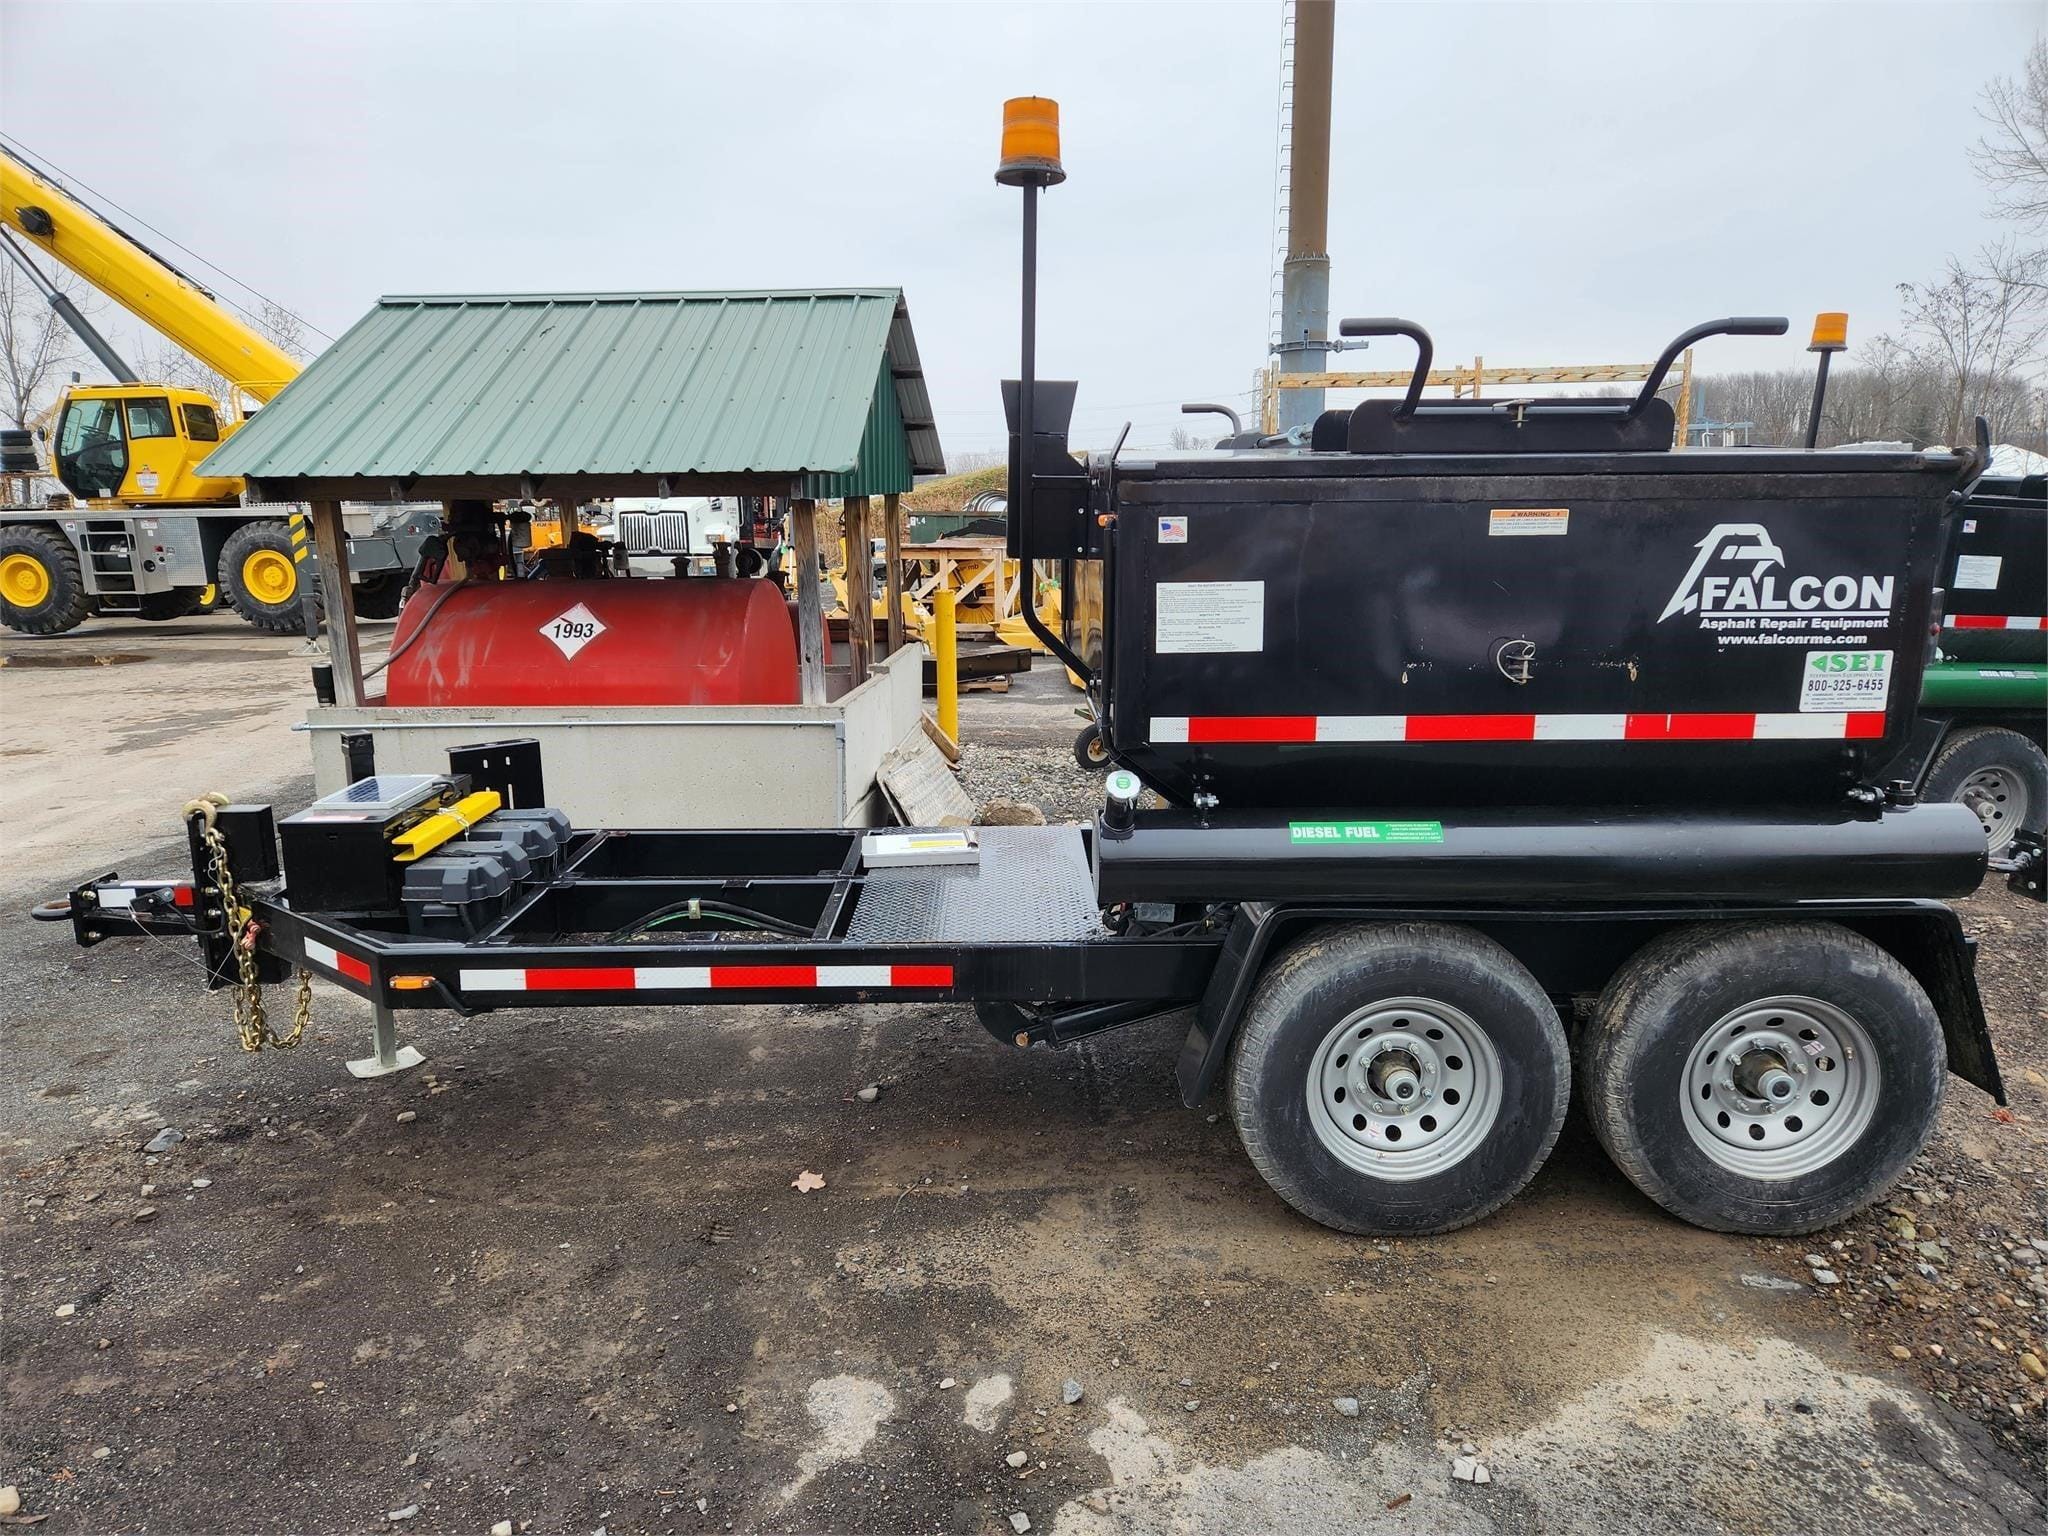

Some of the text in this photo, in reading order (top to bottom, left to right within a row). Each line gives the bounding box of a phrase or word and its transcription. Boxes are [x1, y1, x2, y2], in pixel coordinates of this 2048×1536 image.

[1700, 575, 1895, 610] FALCON
[553, 622, 594, 639] 1993
[1699, 617, 1889, 631] Asphalt Repair Equipment
[1717, 633, 1868, 645] www.falconrme.com
[1828, 653, 1887, 672] SEI
[1807, 679, 1884, 691] 800-325-6455
[1292, 826, 1341, 839] DIESEL
[1345, 826, 1380, 839] FUEL
